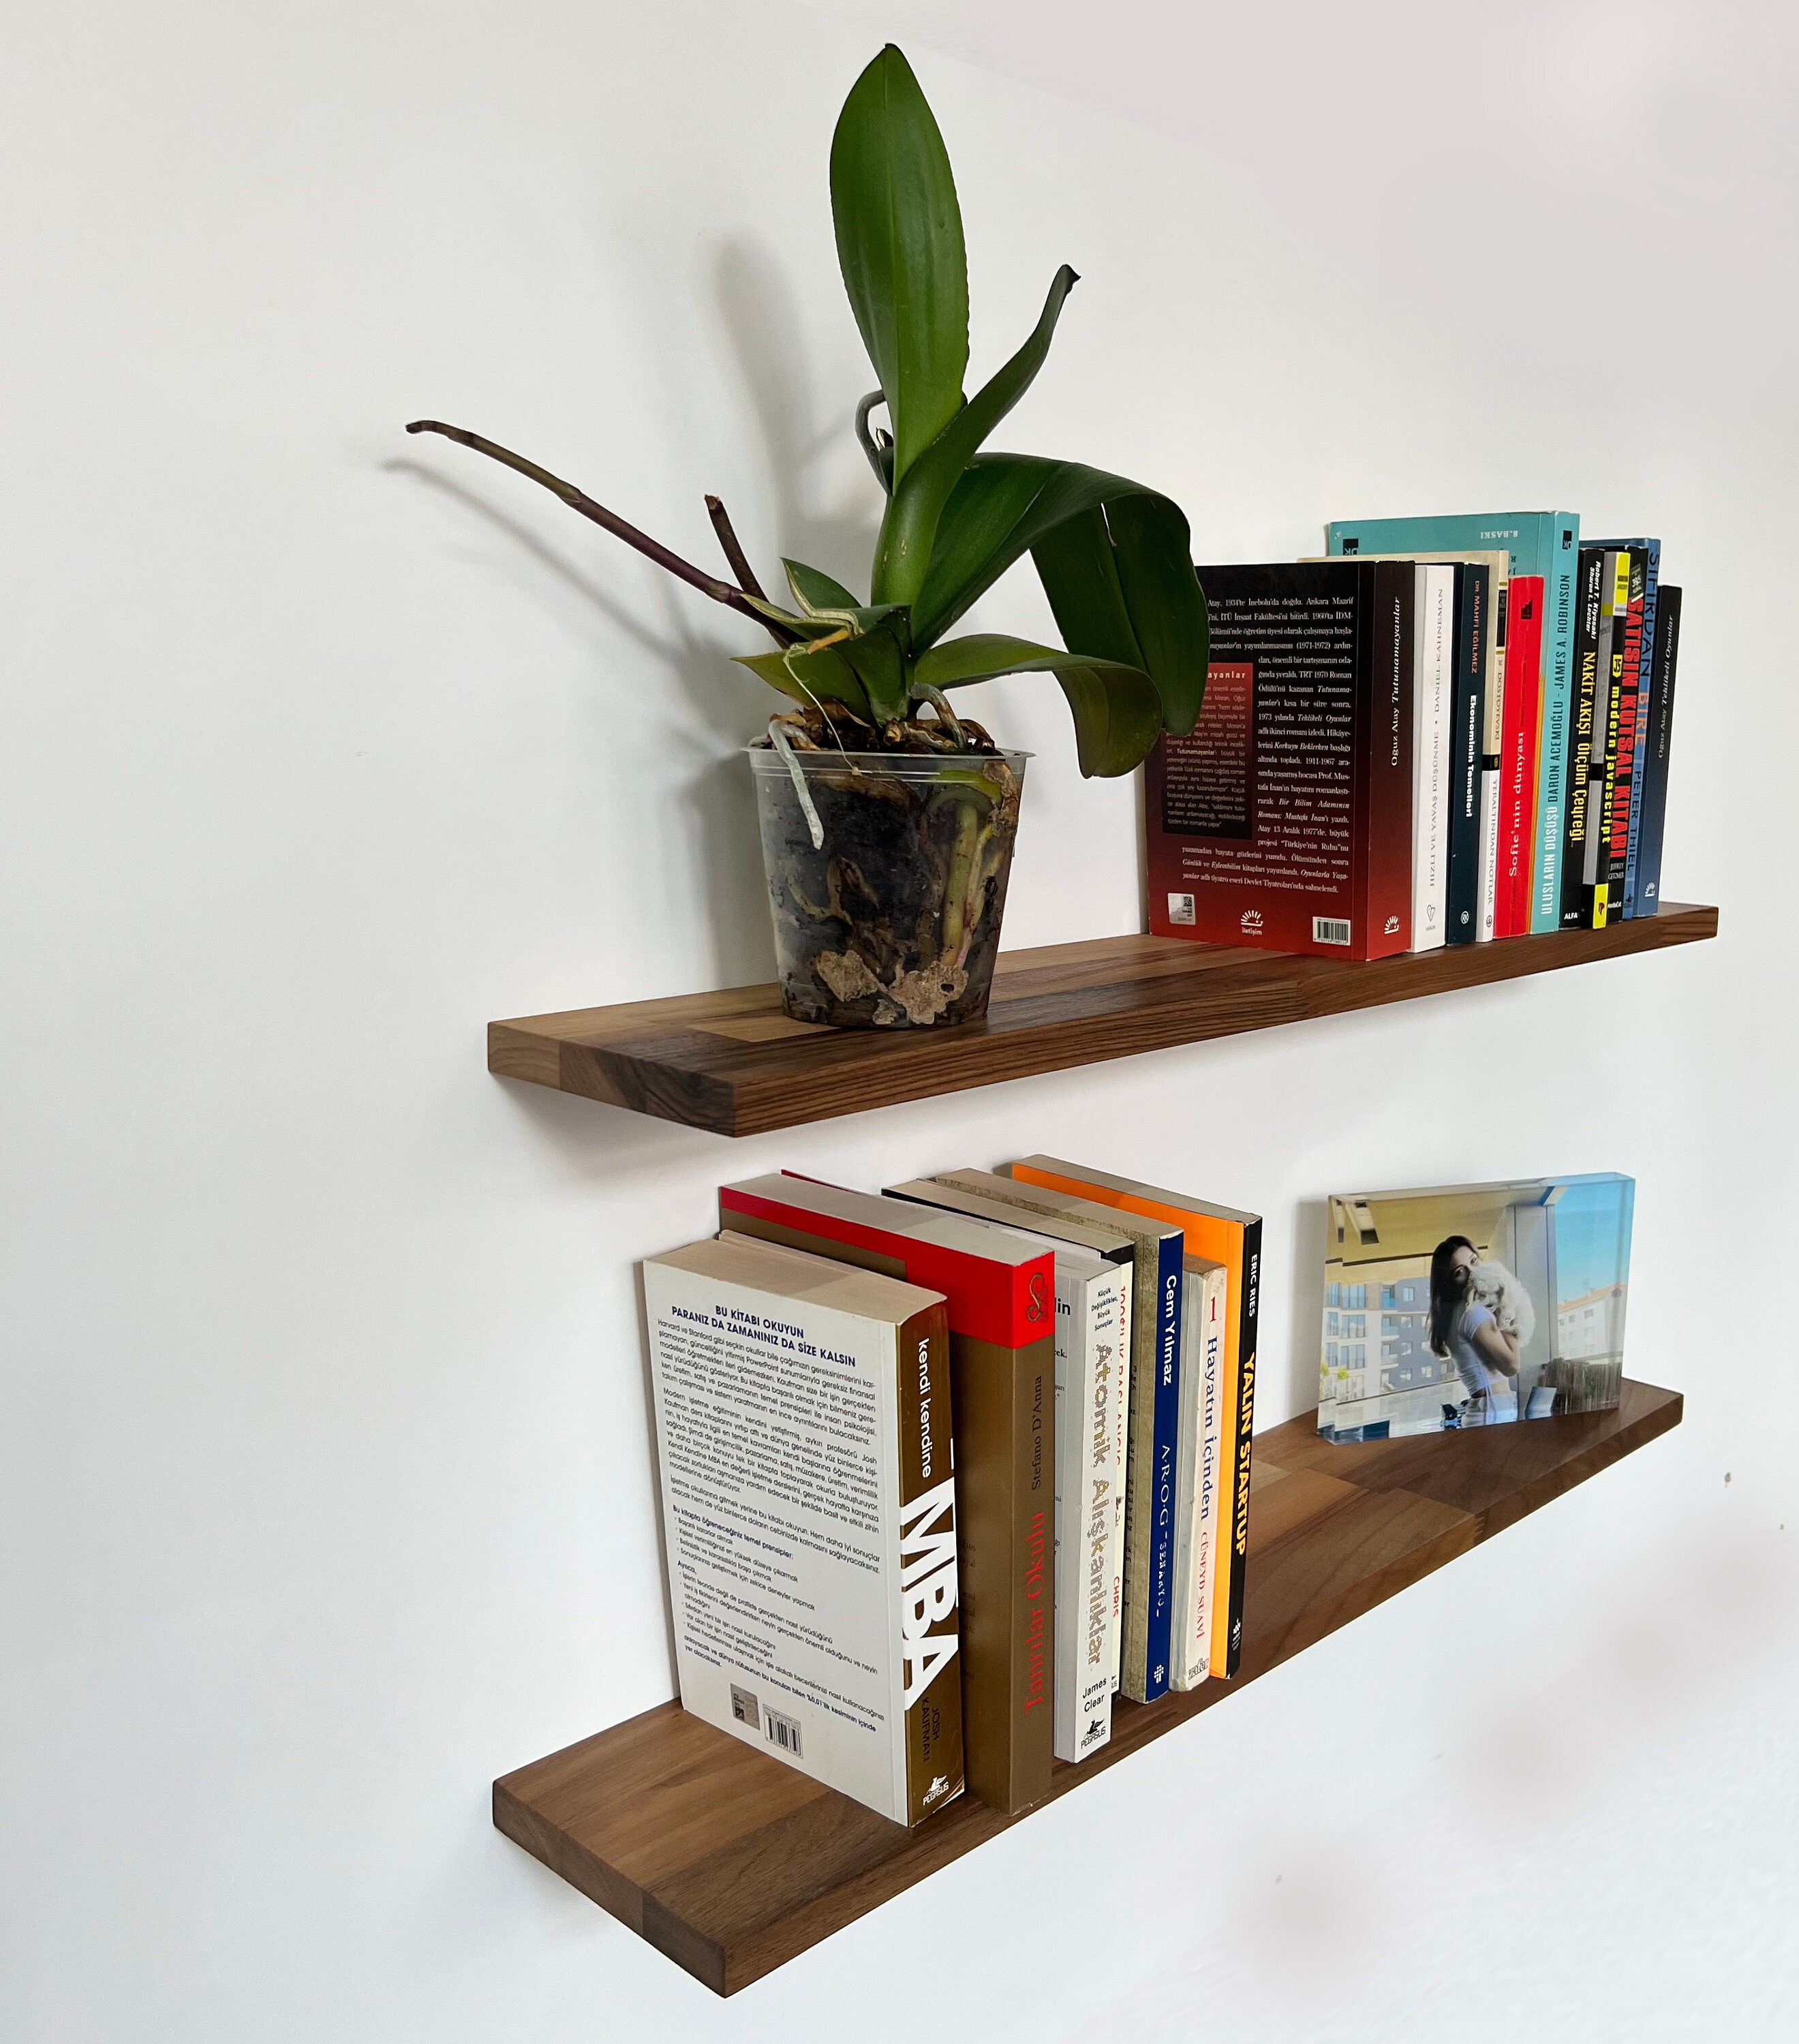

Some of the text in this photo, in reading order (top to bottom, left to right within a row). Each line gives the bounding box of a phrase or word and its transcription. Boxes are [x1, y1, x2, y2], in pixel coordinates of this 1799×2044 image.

[1225, 599, 1246, 607] 1934'te
[1248, 598, 1280, 606] İnebolu'da
[1282, 598, 1303, 606] doğdu.
[1306, 597, 1329, 606] Ankara
[1332, 596, 1354, 605] Maarif
[1588, 593, 1593, 602] L.
[1590, 561, 1601, 640] Robert T. Kiyosaki
[1640, 552, 1660, 677] SIFIRDAN
[1258, 655, 1353, 665] dan, önemli bir tartışmanın oda-
[1665, 615, 1674, 659] Oyunlar
[1391, 596, 1401, 766] Oğuz Atay Tutunamayanlar
[1581, 651, 1596, 696] NAKİT
[1661, 661, 1671, 706] Tehlikeli
[1259, 713, 1352, 724] 1973 yılında Tehlikeli Oyunlar
[1541, 574, 1570, 915] ULUSLARIN DÜŞÜŞÜ DARON ACEMOĞLU JAMES A. ROBINSON
[1575, 698, 1593, 736] AKIŞI
[1615, 695, 1637, 779] KUTSAL
[1466, 695, 1477, 818] Ekonominin Temelleri
[1513, 732, 1526, 794] dünyası
[1601, 686, 1620, 843] modern javascript
[1257, 797, 1274, 805] rarak
[1294, 799, 1312, 807] Bilim
[1317, 800, 1350, 809] Adamının
[1490, 779, 1498, 856] YERALTINDAN
[1569, 789, 1587, 841] Çeyreği
[1631, 771, 1642, 818] PETER
[1257, 824, 1272, 833] Atay
[1282, 826, 1300, 835] Aralık
[1303, 827, 1327, 837] 1977'de,
[1329, 829, 1349, 839] büyük
[1509, 801, 1520, 877] Sofie'nin
[1627, 825, 1640, 872] THIEL
[1241, 927, 1263, 936] iletişim
[1564, 912, 1578, 920] ALFA
[1098, 1287, 1111, 1297] Küçük
[1248, 1254, 1258, 1318] ERIC RIES
[671, 1305, 856, 1367] PARANIZ DA ZAMANINIZ DA SİZE KALSIN
[715, 1305, 804, 1339] BU KİTABI OKUYUN
[1094, 1319, 1113, 1331] Sonuçlar
[1097, 1309, 1111, 1319] Büyük
[1163, 1275, 1177, 1386] Cem Yılmaz
[658, 1318, 681, 1332] Harvard
[688, 1327, 713, 1342] Stanford
[713, 1337, 725, 1346] gibi
[725, 1340, 745, 1351] seçkin
[745, 1346, 767, 1358] okullar
[767, 1351, 779, 1362] bile
[779, 1356, 810, 1371] çağımızın
[810, 1365, 862, 1386] gereksinimlerini
[863, 1378, 876, 1389] kar-
[918, 1337, 933, 1479] kendi kendine
[1205, 1335, 1218, 1429] Hayatın
[663, 1387, 877, 1465] Modern işletme eğitiminin kendini yetiştirmiş, aykırı profesörü Josh
[1032, 1376, 1042, 1491] Stefano D'Anna
[1235, 1351, 1255, 1555] YALIN STARTUP
[1087, 1344, 1113, 1665] Atomik Alışkanlıklar
[1199, 1531, 1209, 1590] CÜNEYD
[900, 1476, 959, 1711] MBA
[1024, 1511, 1045, 1717] Tanrılar Okulu
[1082, 1677, 1107, 1699] James
[1083, 1694, 1105, 1712] Clear
[922, 1697, 930, 1762] KAUFMAN
[932, 1705, 940, 1741] JOSH
[1081, 1726, 1106, 1750] PEGASUS
[923, 1781, 949, 1806] PEGASUS
